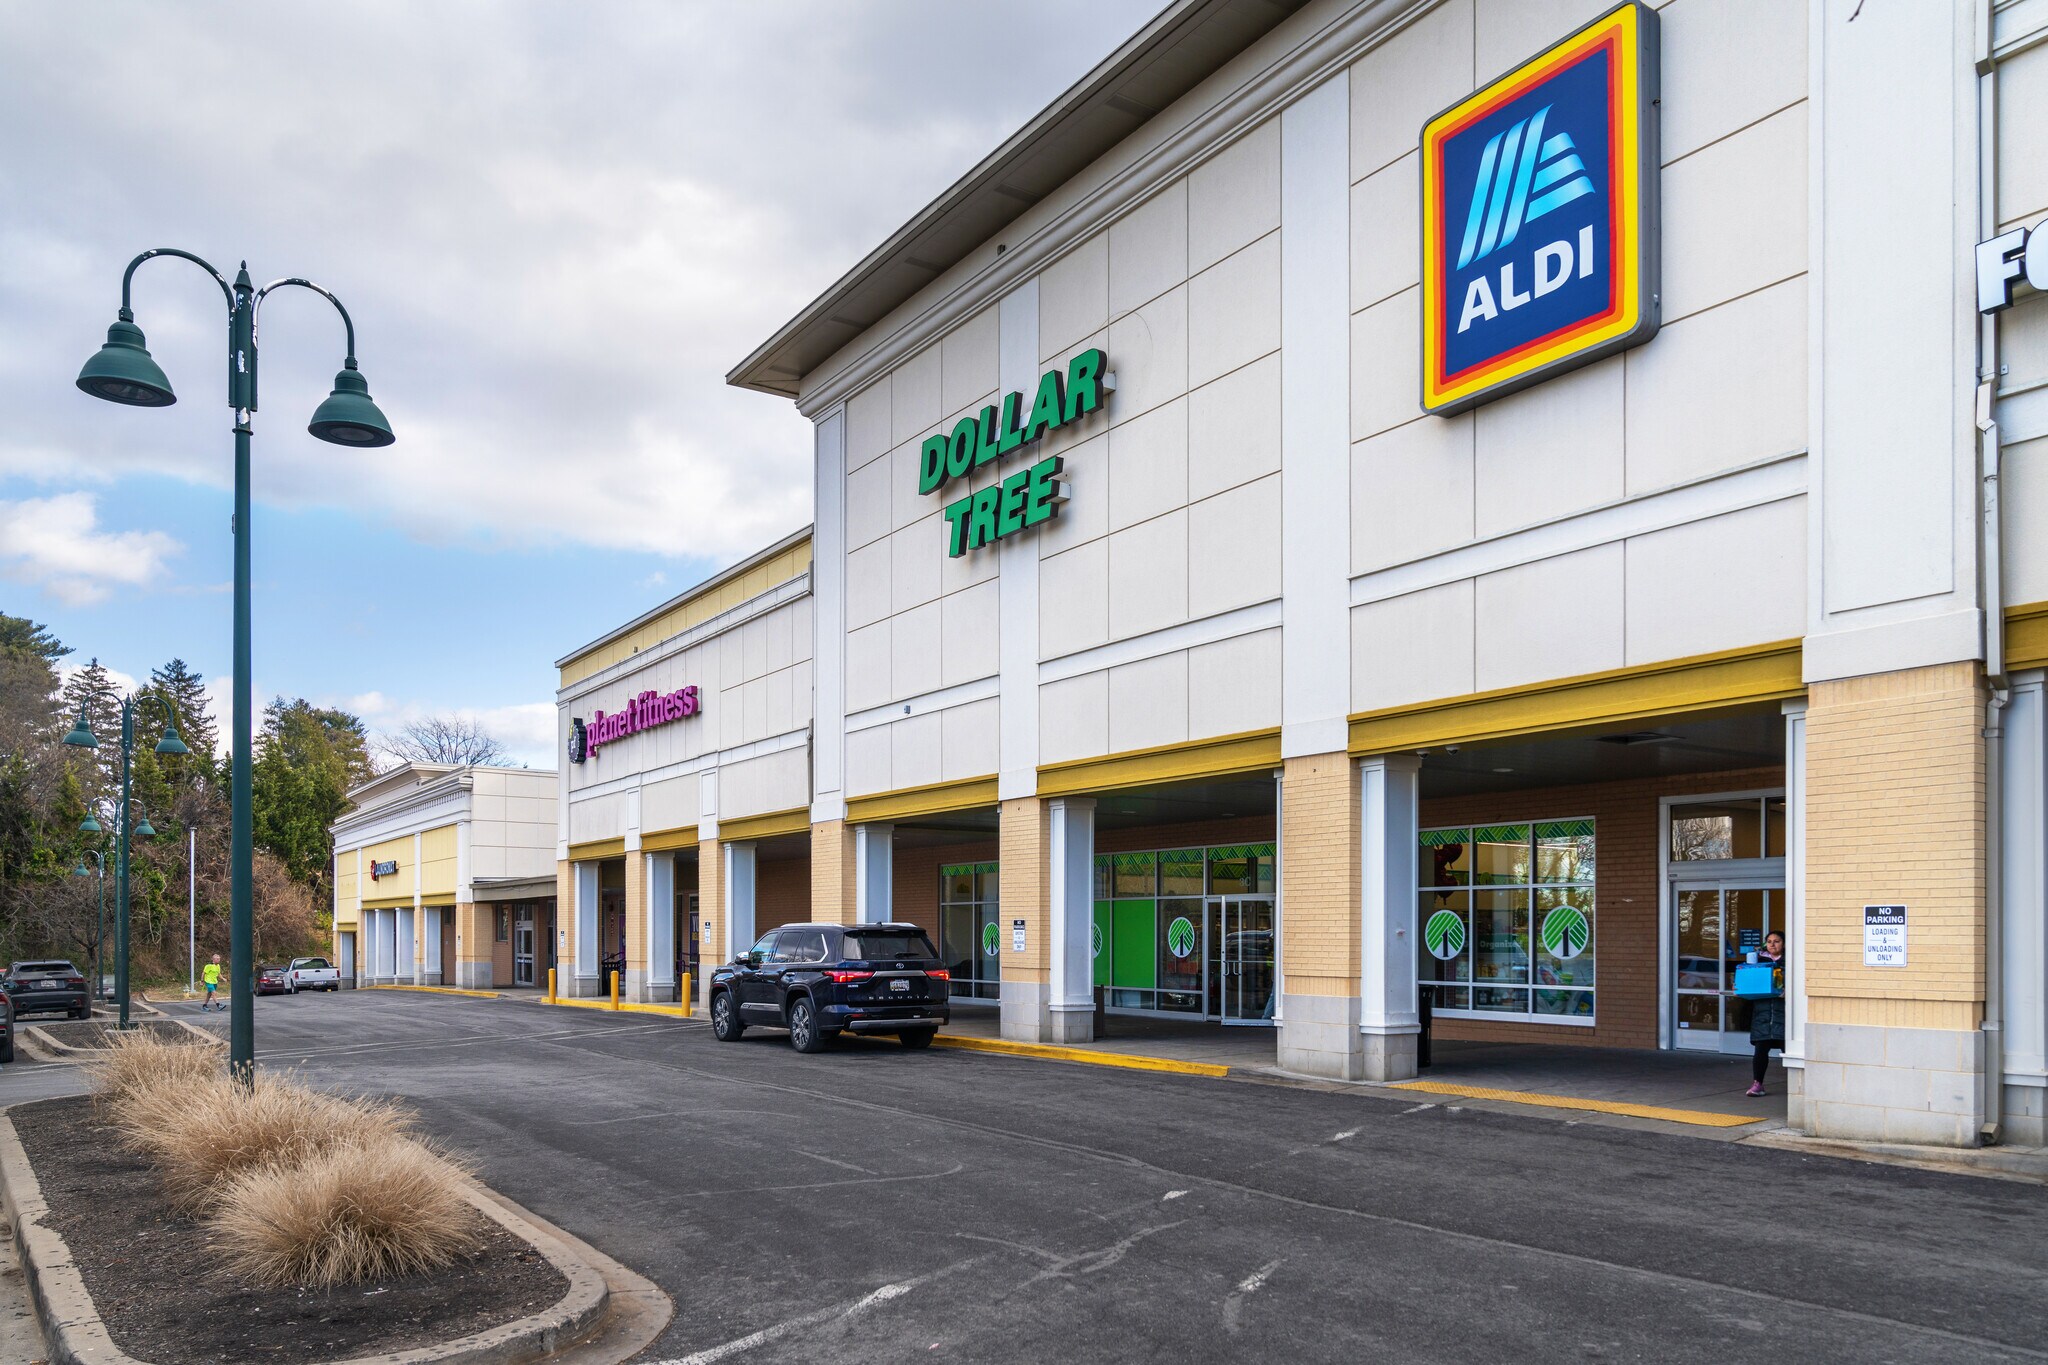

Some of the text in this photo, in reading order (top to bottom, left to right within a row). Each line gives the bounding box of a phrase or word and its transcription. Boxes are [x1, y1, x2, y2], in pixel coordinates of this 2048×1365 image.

[1457, 224, 1594, 334] ALDI
[919, 348, 1107, 495] DOLLAR
[945, 455, 1064, 558] TREE
[586, 685, 697, 758] planet fitness
